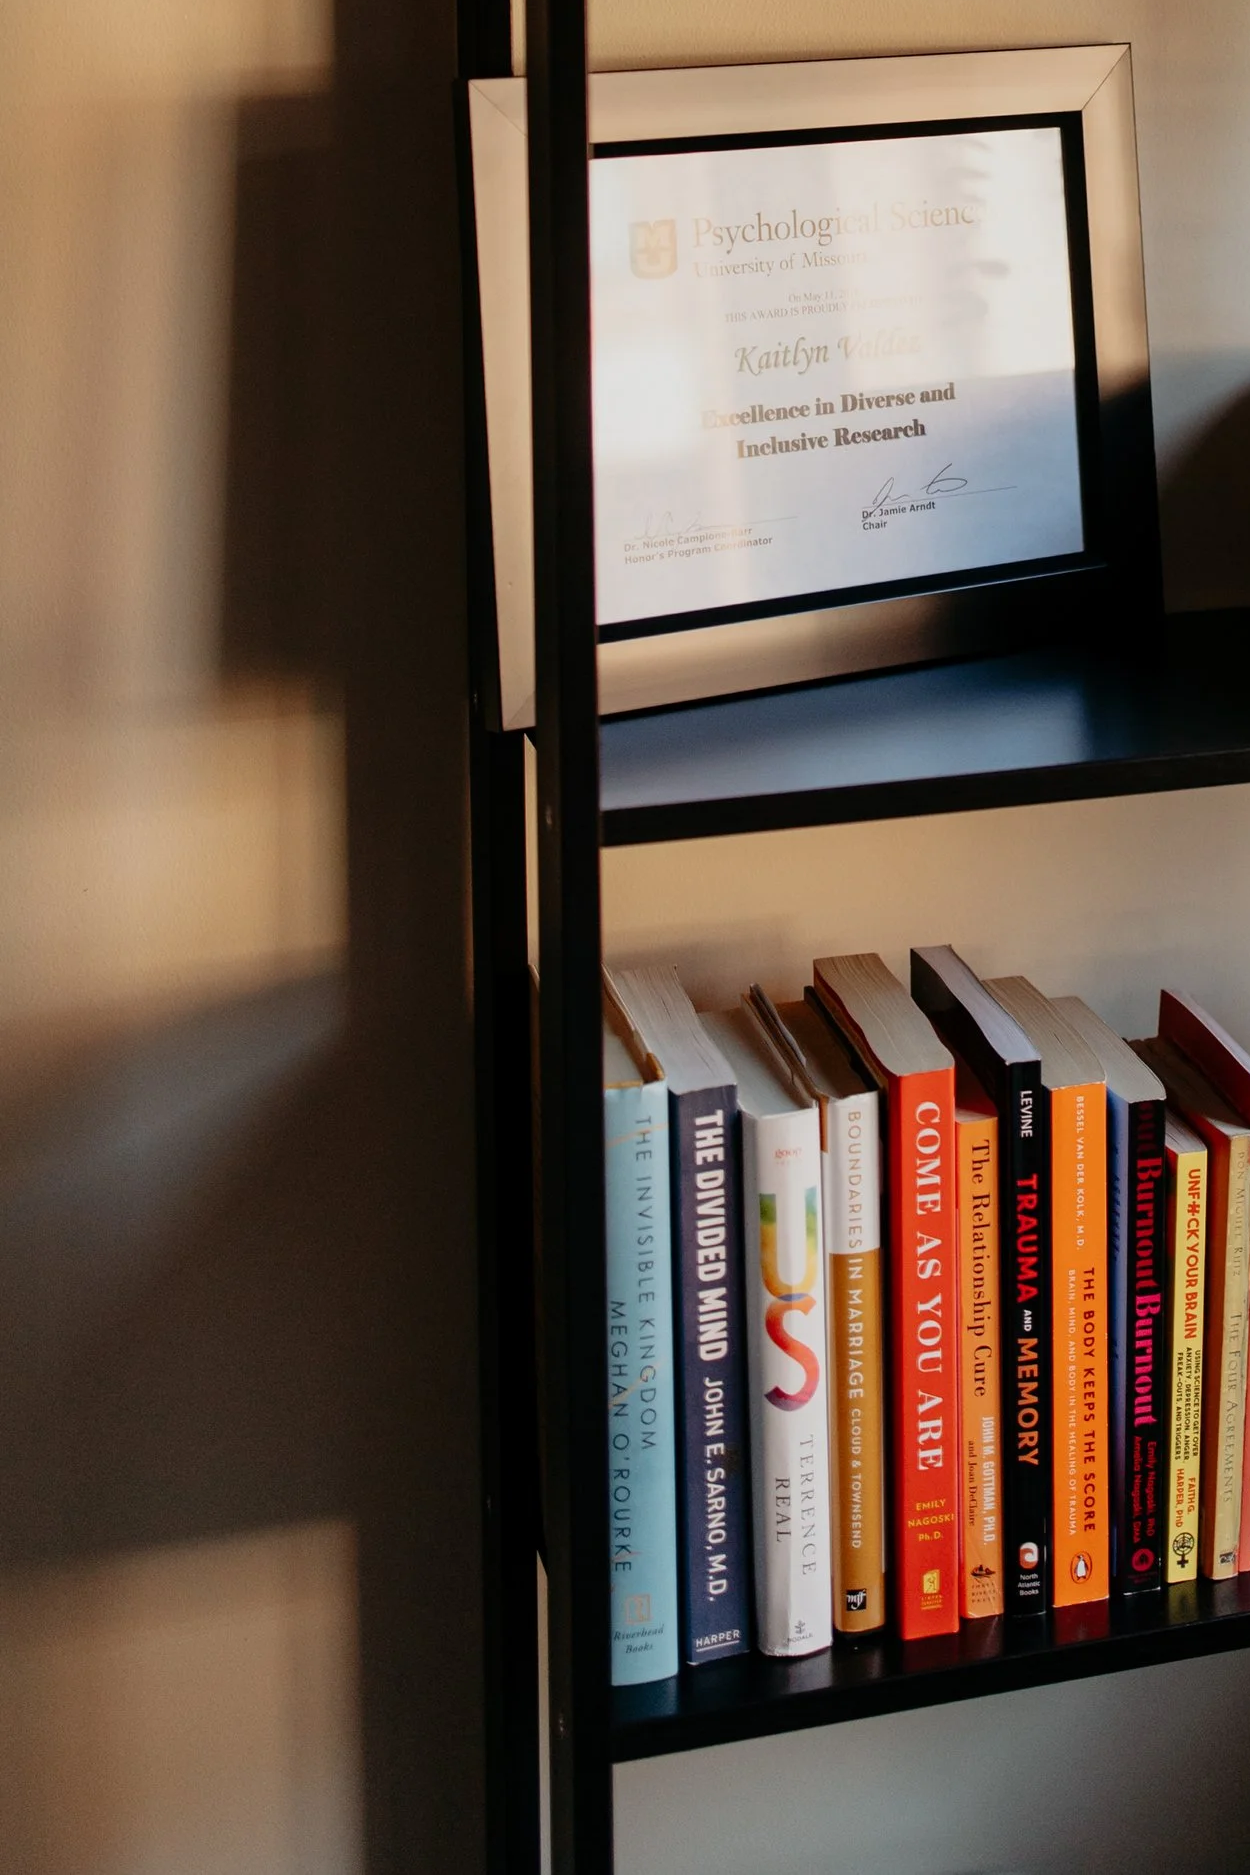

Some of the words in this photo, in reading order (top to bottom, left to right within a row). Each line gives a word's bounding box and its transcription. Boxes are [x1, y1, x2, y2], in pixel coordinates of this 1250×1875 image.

[694, 259, 775, 277] University
[780, 255, 797, 271] of
[735, 336, 829, 376] Kaitlyn
[700, 401, 811, 429] Excellence
[814, 397, 836, 416] in
[840, 389, 916, 413] Diverse
[919, 381, 957, 403] and
[736, 431, 829, 460] Inclusive
[833, 419, 926, 447] Research
[861, 509, 877, 520] Dr.
[878, 504, 907, 518] Jamie
[909, 500, 937, 513] Arndt
[862, 519, 889, 531] Chair
[635, 1115, 653, 1161] THE
[694, 1109, 724, 1166] THE
[1020, 1090, 1034, 1138] LEVINE
[847, 1111, 863, 1249] BOUNDARIES
[915, 1101, 942, 1215] COME
[970, 1139, 990, 1184] The
[636, 1176, 655, 1304] INVISIBLE
[696, 1169, 727, 1282] DIVIDED
[1016, 1173, 1039, 1304] TRAUMA
[1135, 1157, 1162, 1292] Burnout
[848, 1257, 863, 1279] IN
[916, 1231, 943, 1280] AS
[967, 1192, 993, 1337] Relationship
[1185, 1243, 1199, 1288] YOUR
[1083, 1267, 1095, 1301] THE
[697, 1287, 729, 1362] MIND
[916, 1292, 943, 1374] YOU
[1023, 1309, 1033, 1332] AND
[1083, 1310, 1096, 1358] BODY
[1184, 1291, 1199, 1340] BRAIN
[609, 1300, 628, 1417] MEGHAN
[848, 1288, 864, 1400] MARRIAGE
[1134, 1292, 1161, 1428] Burnout
[638, 1317, 658, 1450] KINGDOM
[972, 1344, 993, 1398] Cure
[1083, 1367, 1096, 1422] KEEPS
[703, 1376, 725, 1437] JOHN
[1017, 1337, 1039, 1466] MEMORY
[705, 1442, 726, 1464] E.
[851, 1408, 863, 1455] CLOUD
[916, 1389, 944, 1471] ARE
[1084, 1429, 1096, 1465] THE
[851, 1459, 862, 1469] &
[611, 1432, 632, 1573] O'ROURKE
[706, 1466, 728, 1550] SARNO,
[775, 1476, 792, 1543] REAL
[799, 1434, 817, 1575] TERRENCE
[851, 1473, 863, 1549] TOWNSEND
[907, 1513, 956, 1529] NAGOSKI
[915, 1498, 947, 1512] EMILY
[1083, 1472, 1096, 1533] SCORE
[918, 1530, 944, 1543] Ph.D.
[707, 1553, 728, 1602] M.D.
[695, 1629, 740, 1648] HARPER
